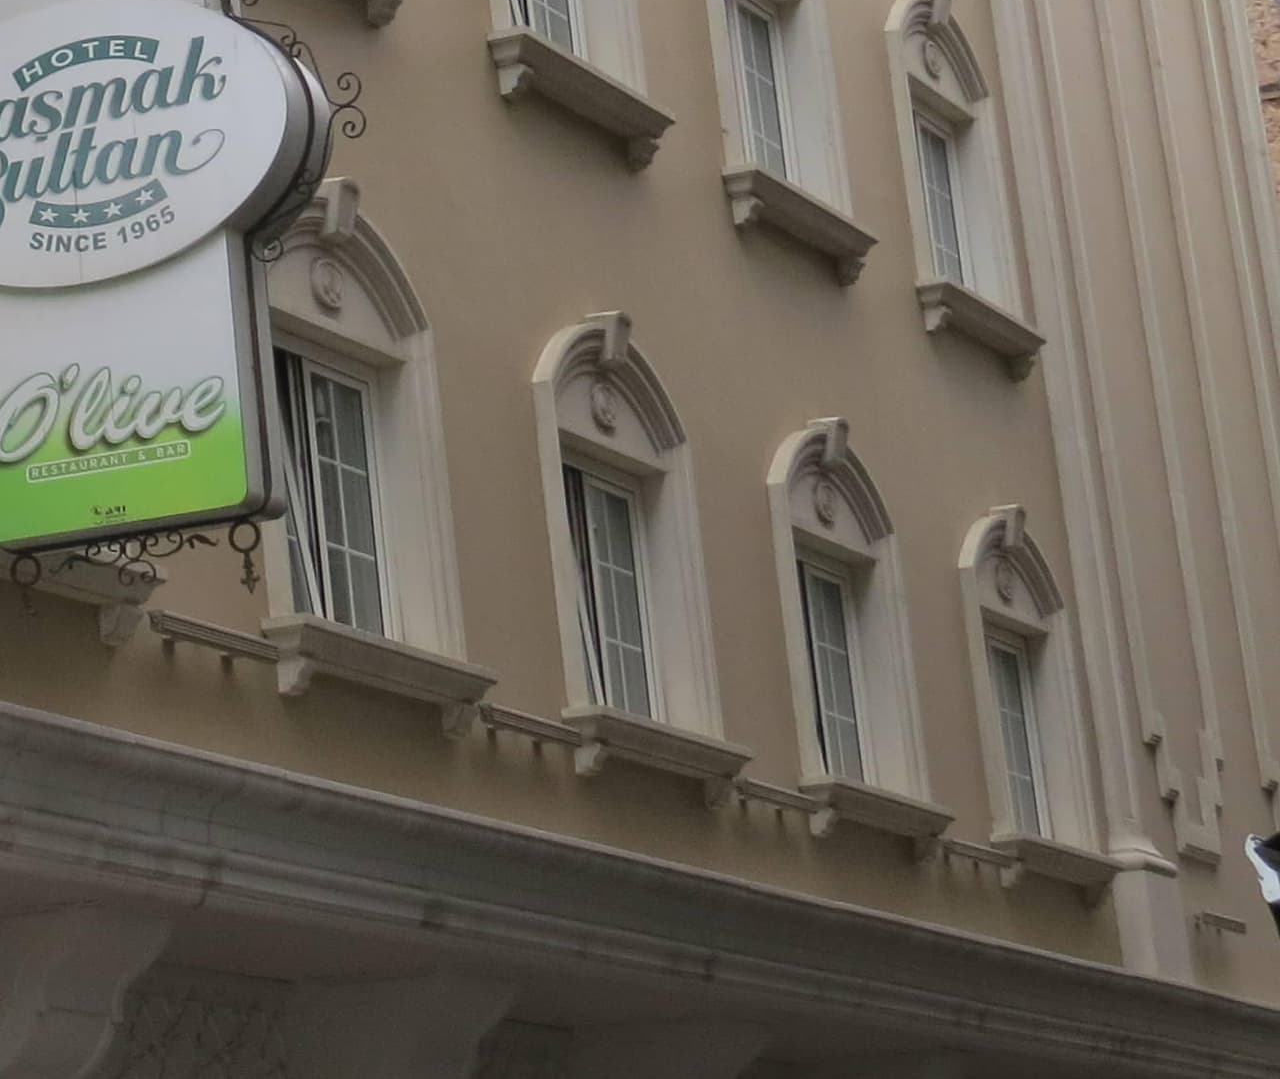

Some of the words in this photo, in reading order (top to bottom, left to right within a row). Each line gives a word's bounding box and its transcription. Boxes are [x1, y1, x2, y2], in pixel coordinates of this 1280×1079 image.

[22, 40, 149, 83] HOTEL
[29, 232, 107, 252] SINCE
[116, 205, 175, 244] 1965
[31, 453, 129, 479] RESTAURANT
[138, 450, 146, 461] &
[157, 443, 186, 458] BAR
